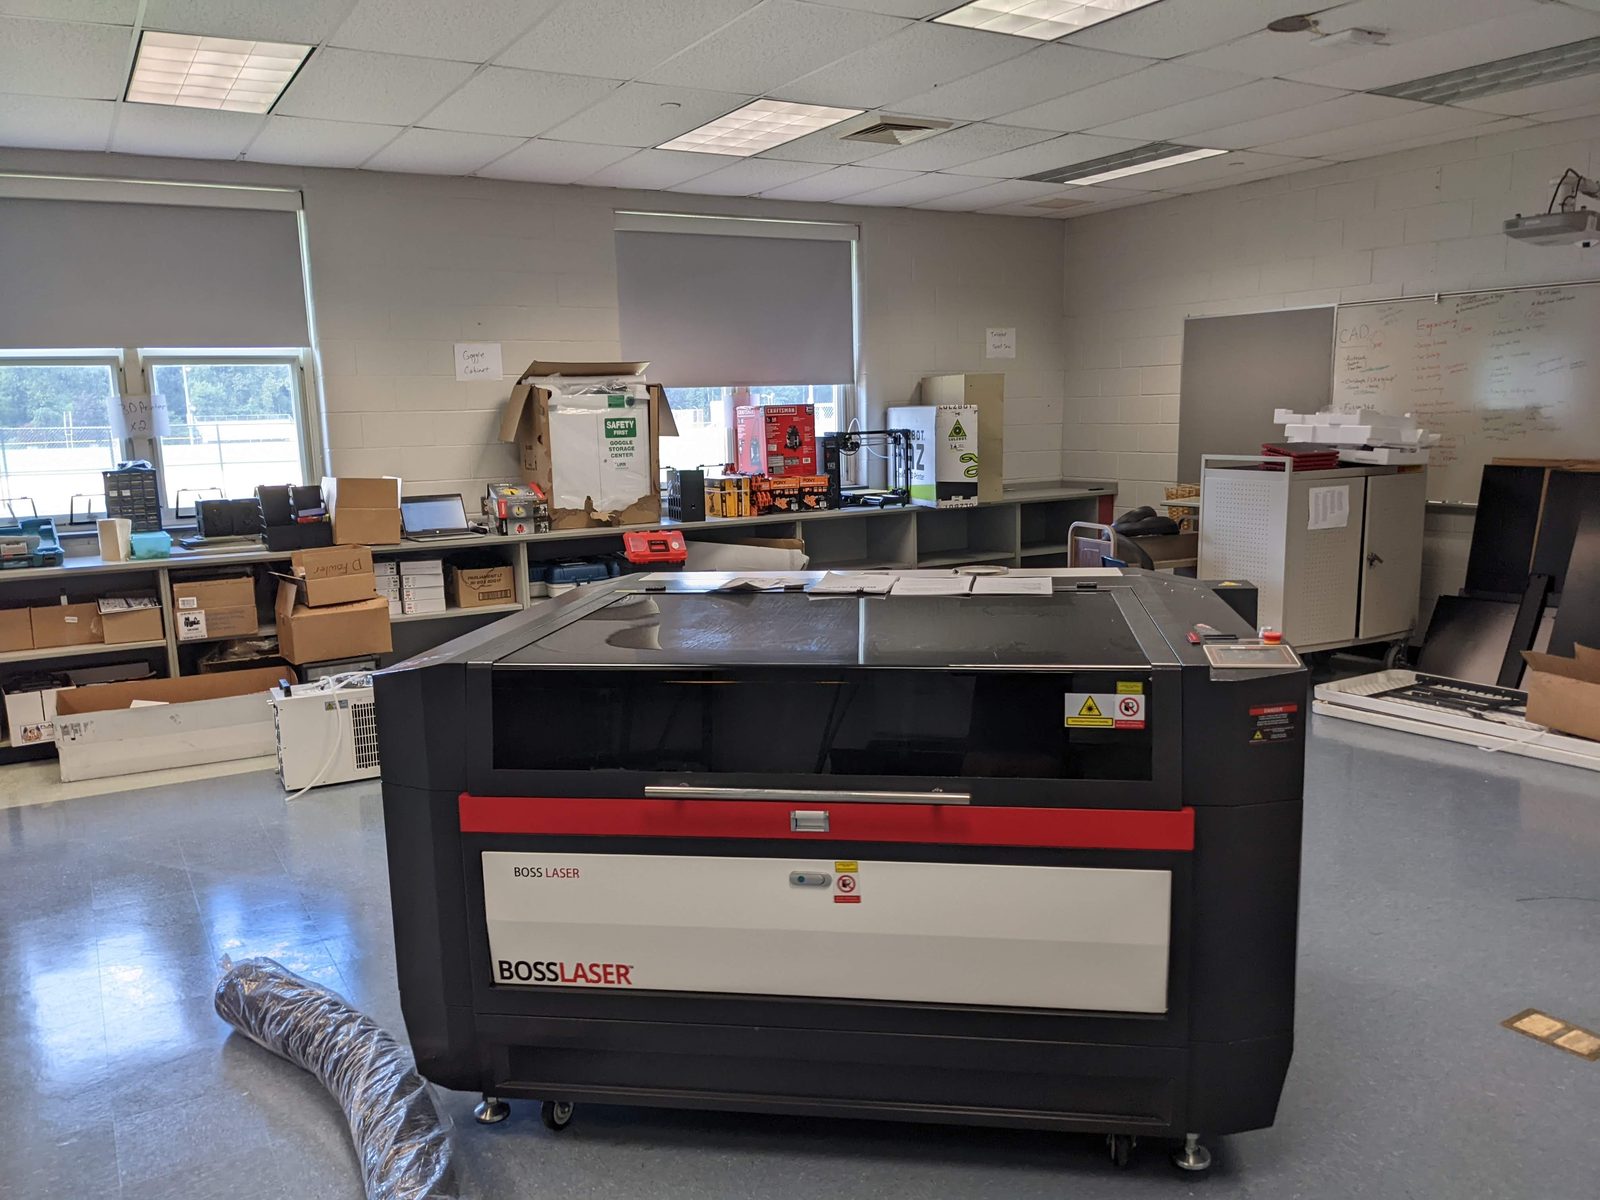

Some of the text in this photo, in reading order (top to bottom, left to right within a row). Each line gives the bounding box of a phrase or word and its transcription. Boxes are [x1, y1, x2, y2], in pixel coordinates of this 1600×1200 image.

[606, 420, 634, 429] SAFETY
[514, 867, 580, 879] BOSS LASER
